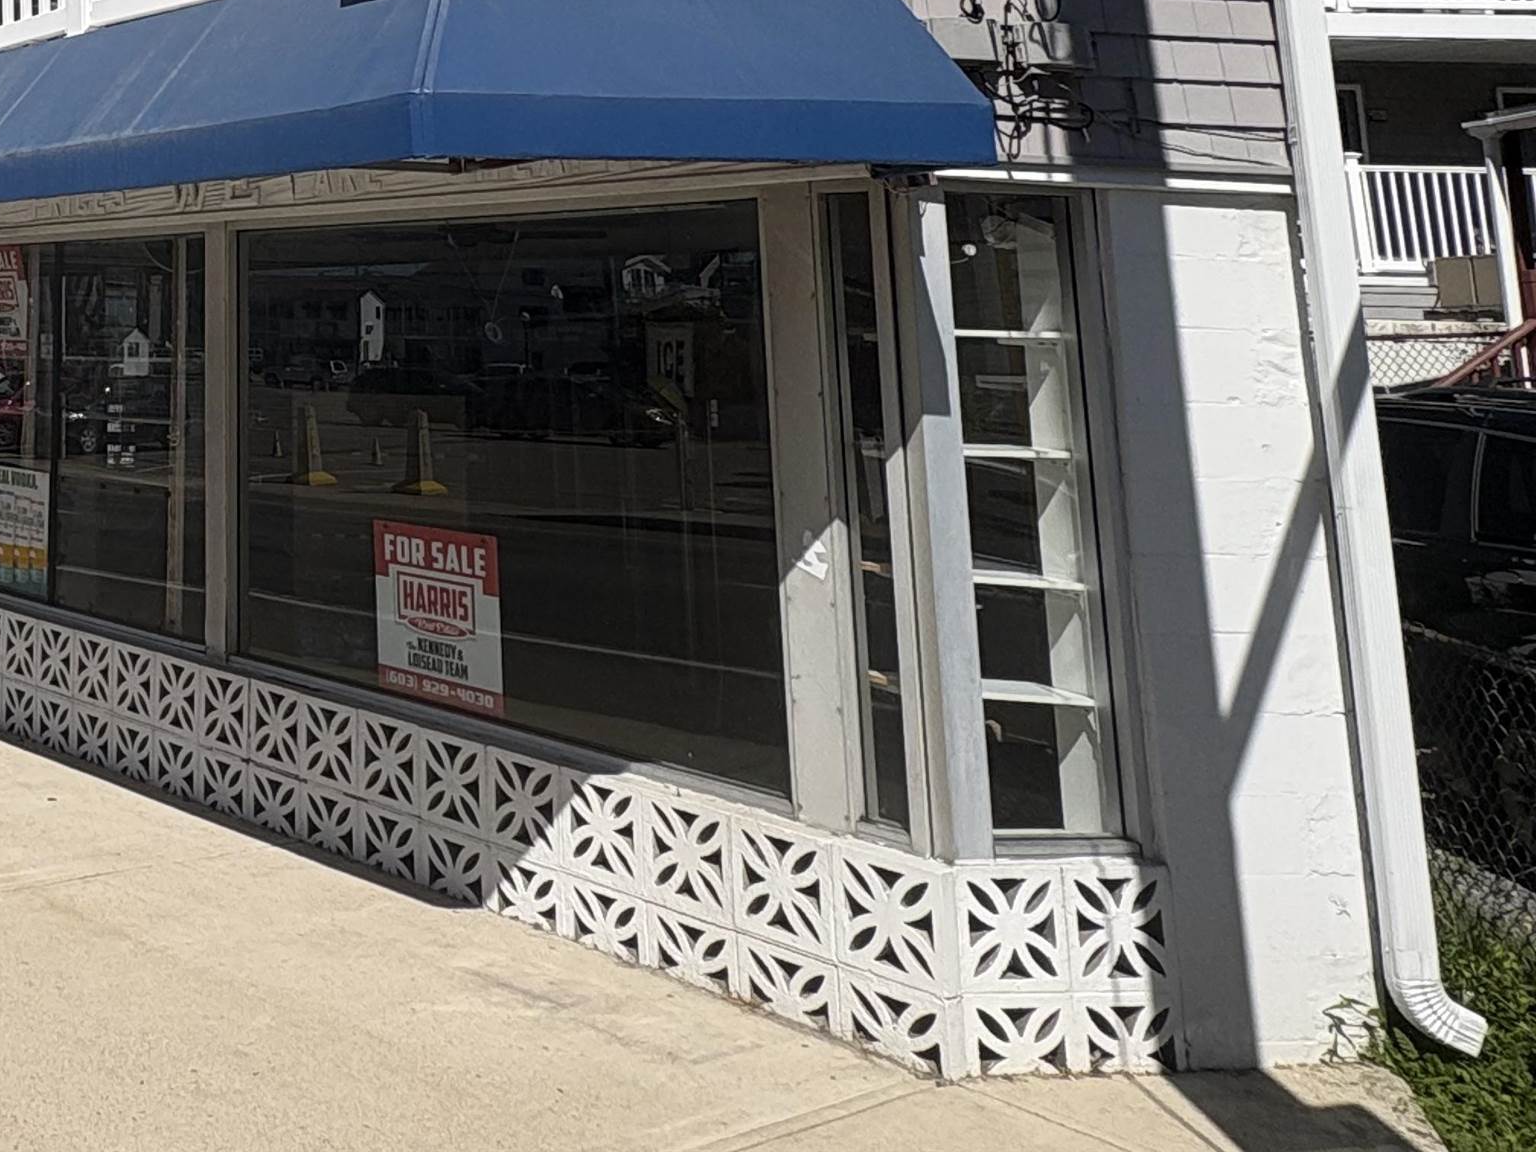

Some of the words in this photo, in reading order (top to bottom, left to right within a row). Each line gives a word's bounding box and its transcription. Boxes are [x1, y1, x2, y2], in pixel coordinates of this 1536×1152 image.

[383, 533, 425, 566] FOR
[431, 541, 487, 578] SALE
[402, 579, 470, 622] HARRIS
[386, 670, 418, 691] (603)
[421, 679, 495, 709] 929-4030
[444, 660, 469, 681] TEAM
